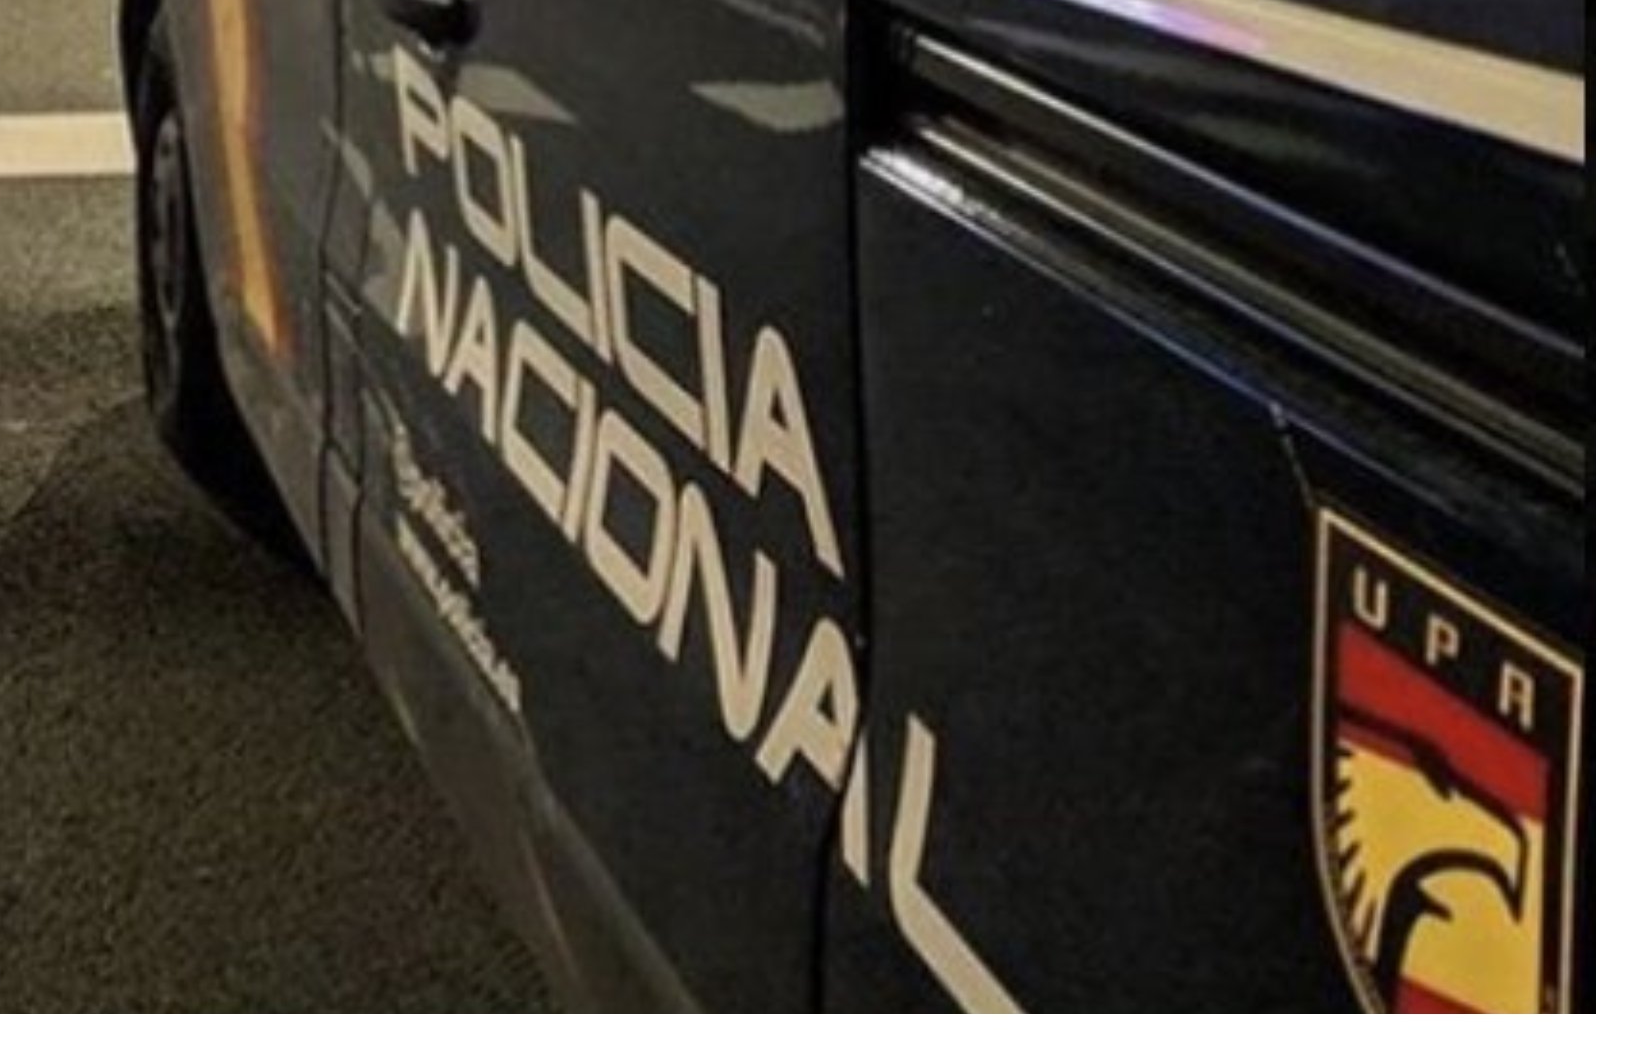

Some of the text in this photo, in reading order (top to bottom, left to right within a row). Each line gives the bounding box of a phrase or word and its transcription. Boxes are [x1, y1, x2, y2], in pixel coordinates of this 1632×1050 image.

[392, 42, 845, 580] POLICIA
[395, 209, 1030, 1015] NACIONAL
[1351, 564, 1538, 731] UPR
